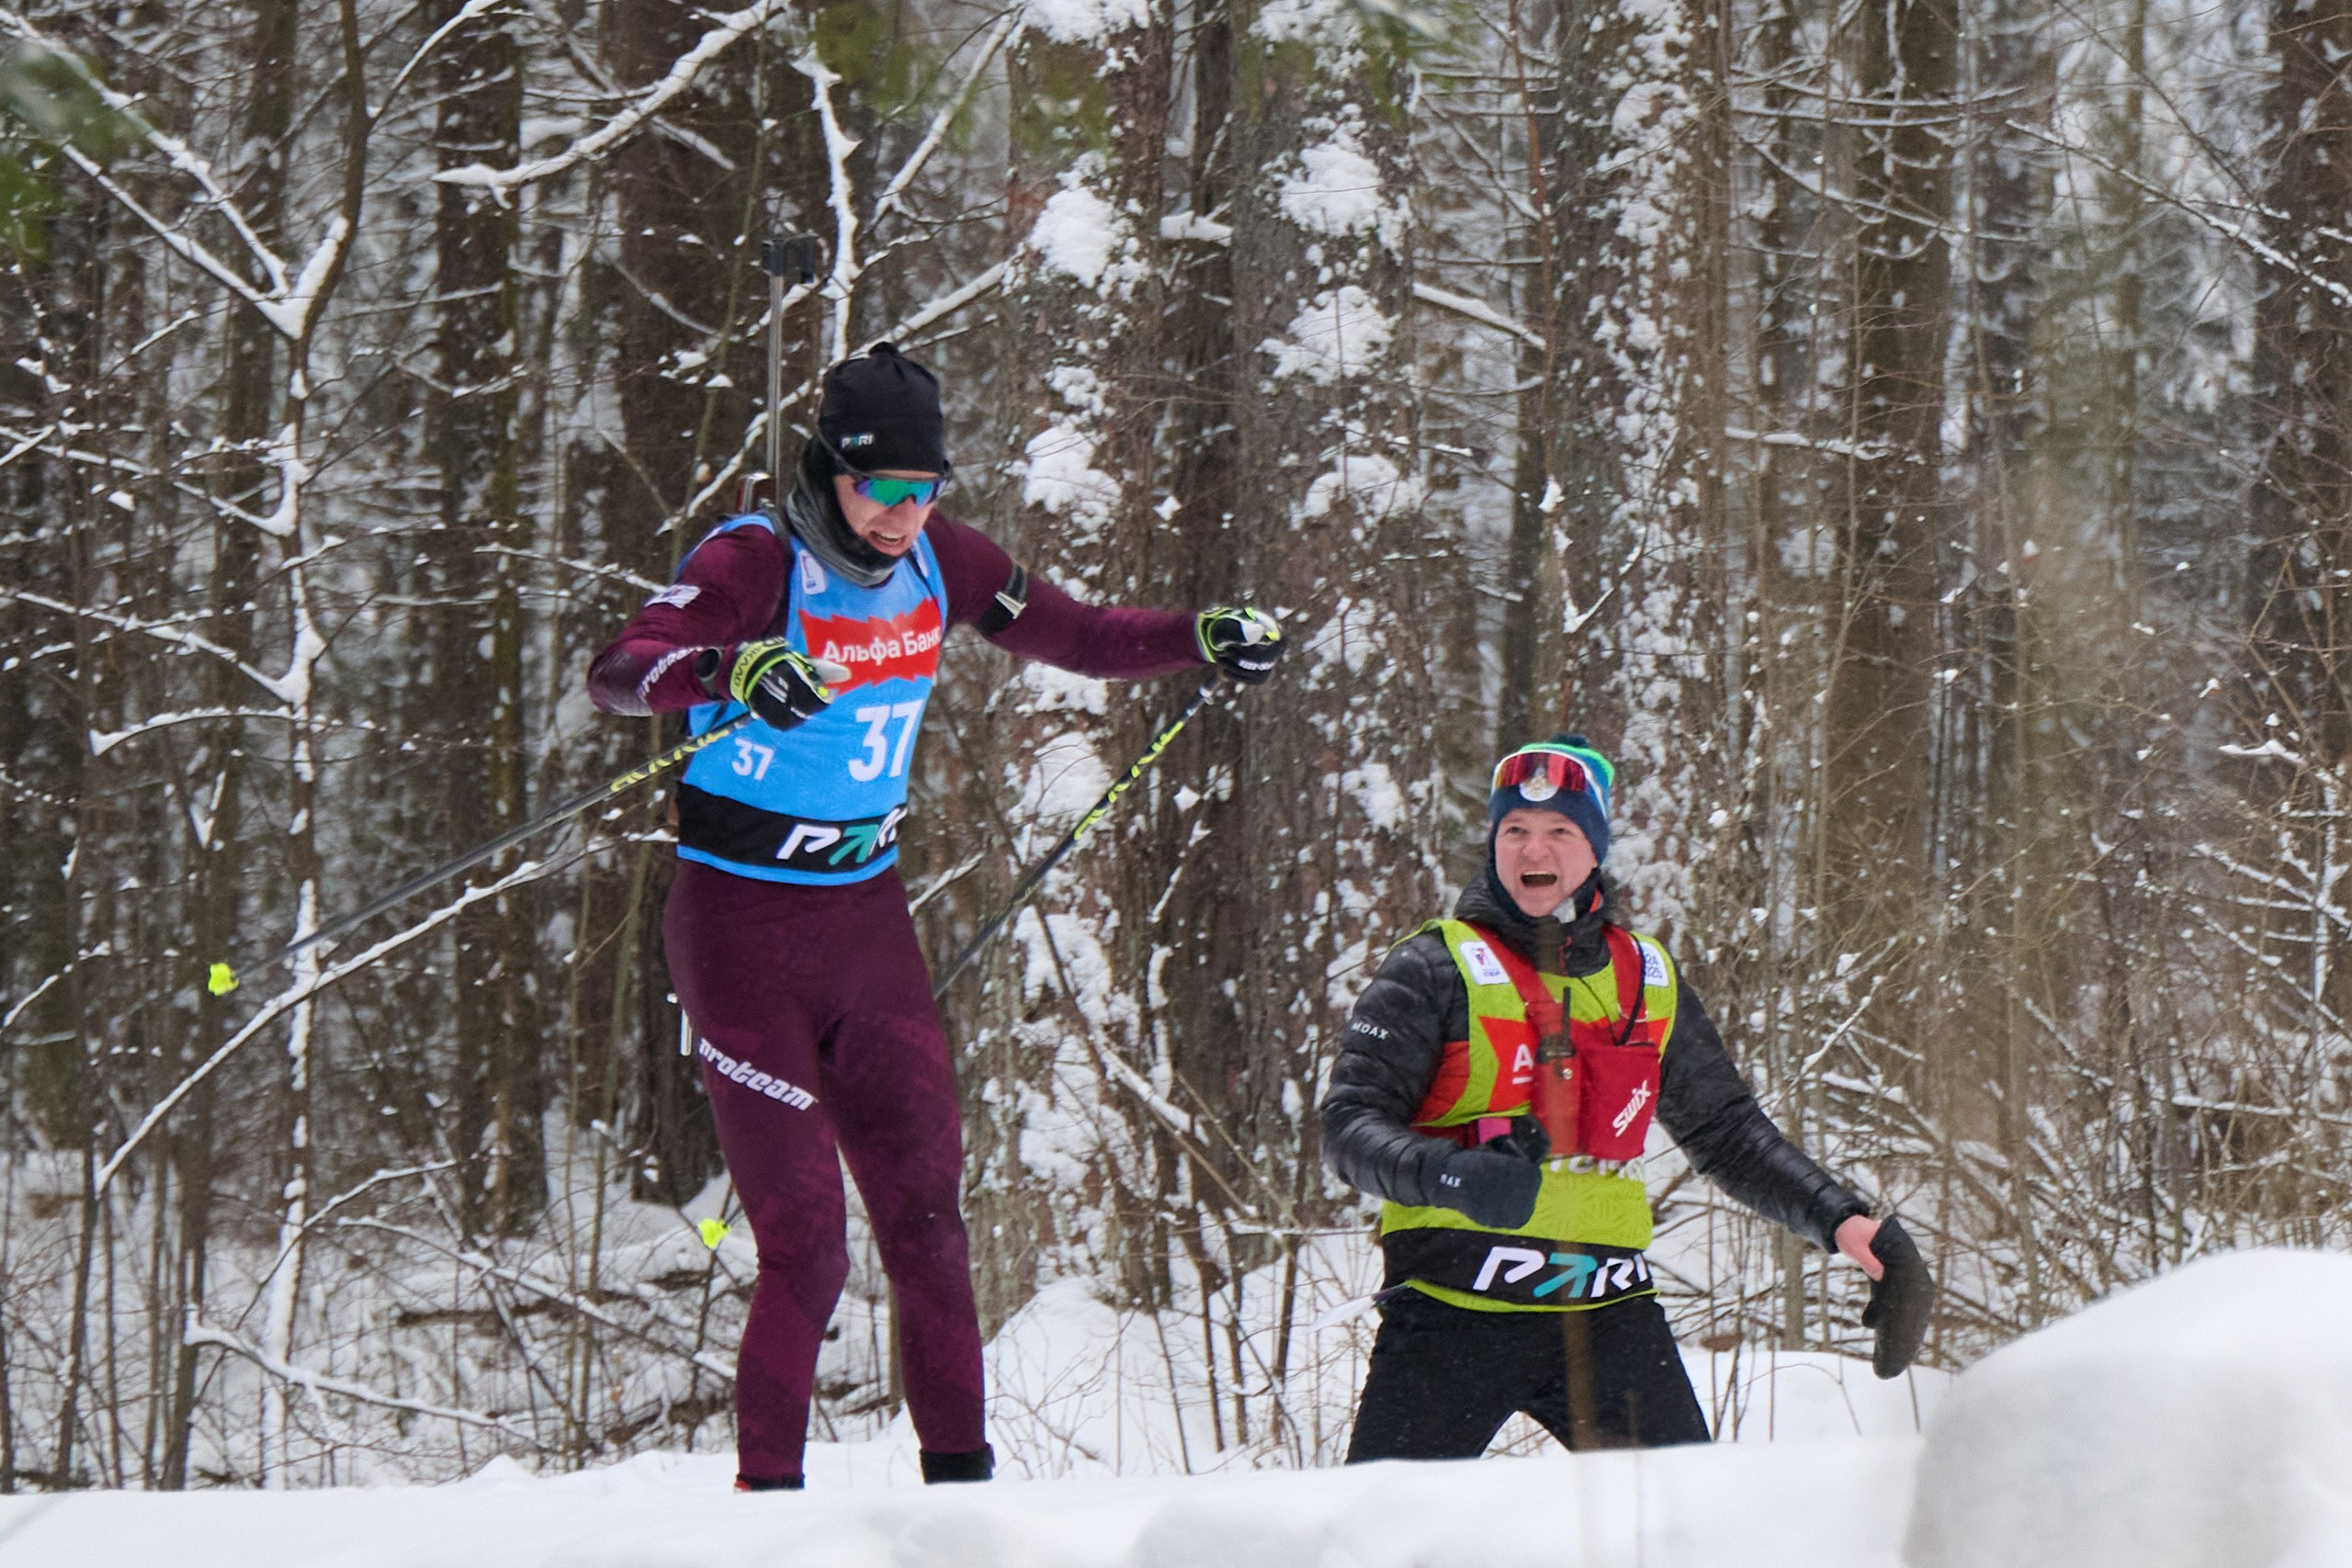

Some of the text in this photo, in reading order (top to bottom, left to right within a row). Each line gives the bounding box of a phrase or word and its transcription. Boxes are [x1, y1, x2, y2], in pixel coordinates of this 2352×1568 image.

[822, 636, 901, 666] Альфа
[730, 738, 775, 781] 37
[848, 699, 923, 782] 37
[1473, 1246, 1648, 1299] PARI
